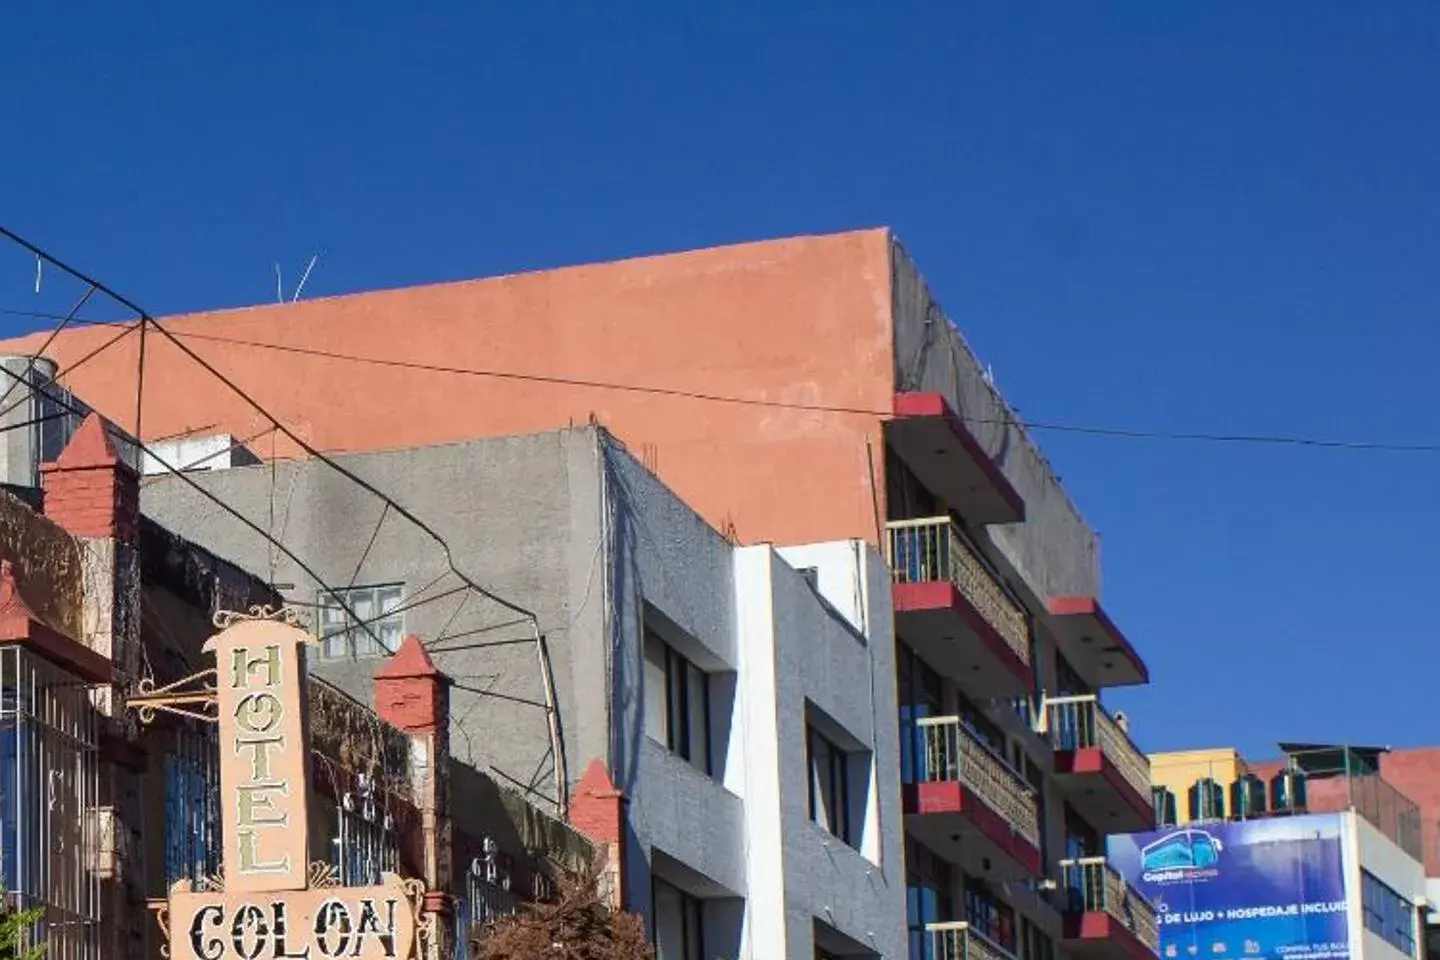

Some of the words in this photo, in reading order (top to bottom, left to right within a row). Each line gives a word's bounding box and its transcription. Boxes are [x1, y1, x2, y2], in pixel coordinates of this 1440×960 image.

[230, 645, 289, 873] HOTEL
[1165, 913, 1181, 925] DE
[1184, 909, 1215, 922] LUJO
[1226, 903, 1299, 919] HOSPEDAJE
